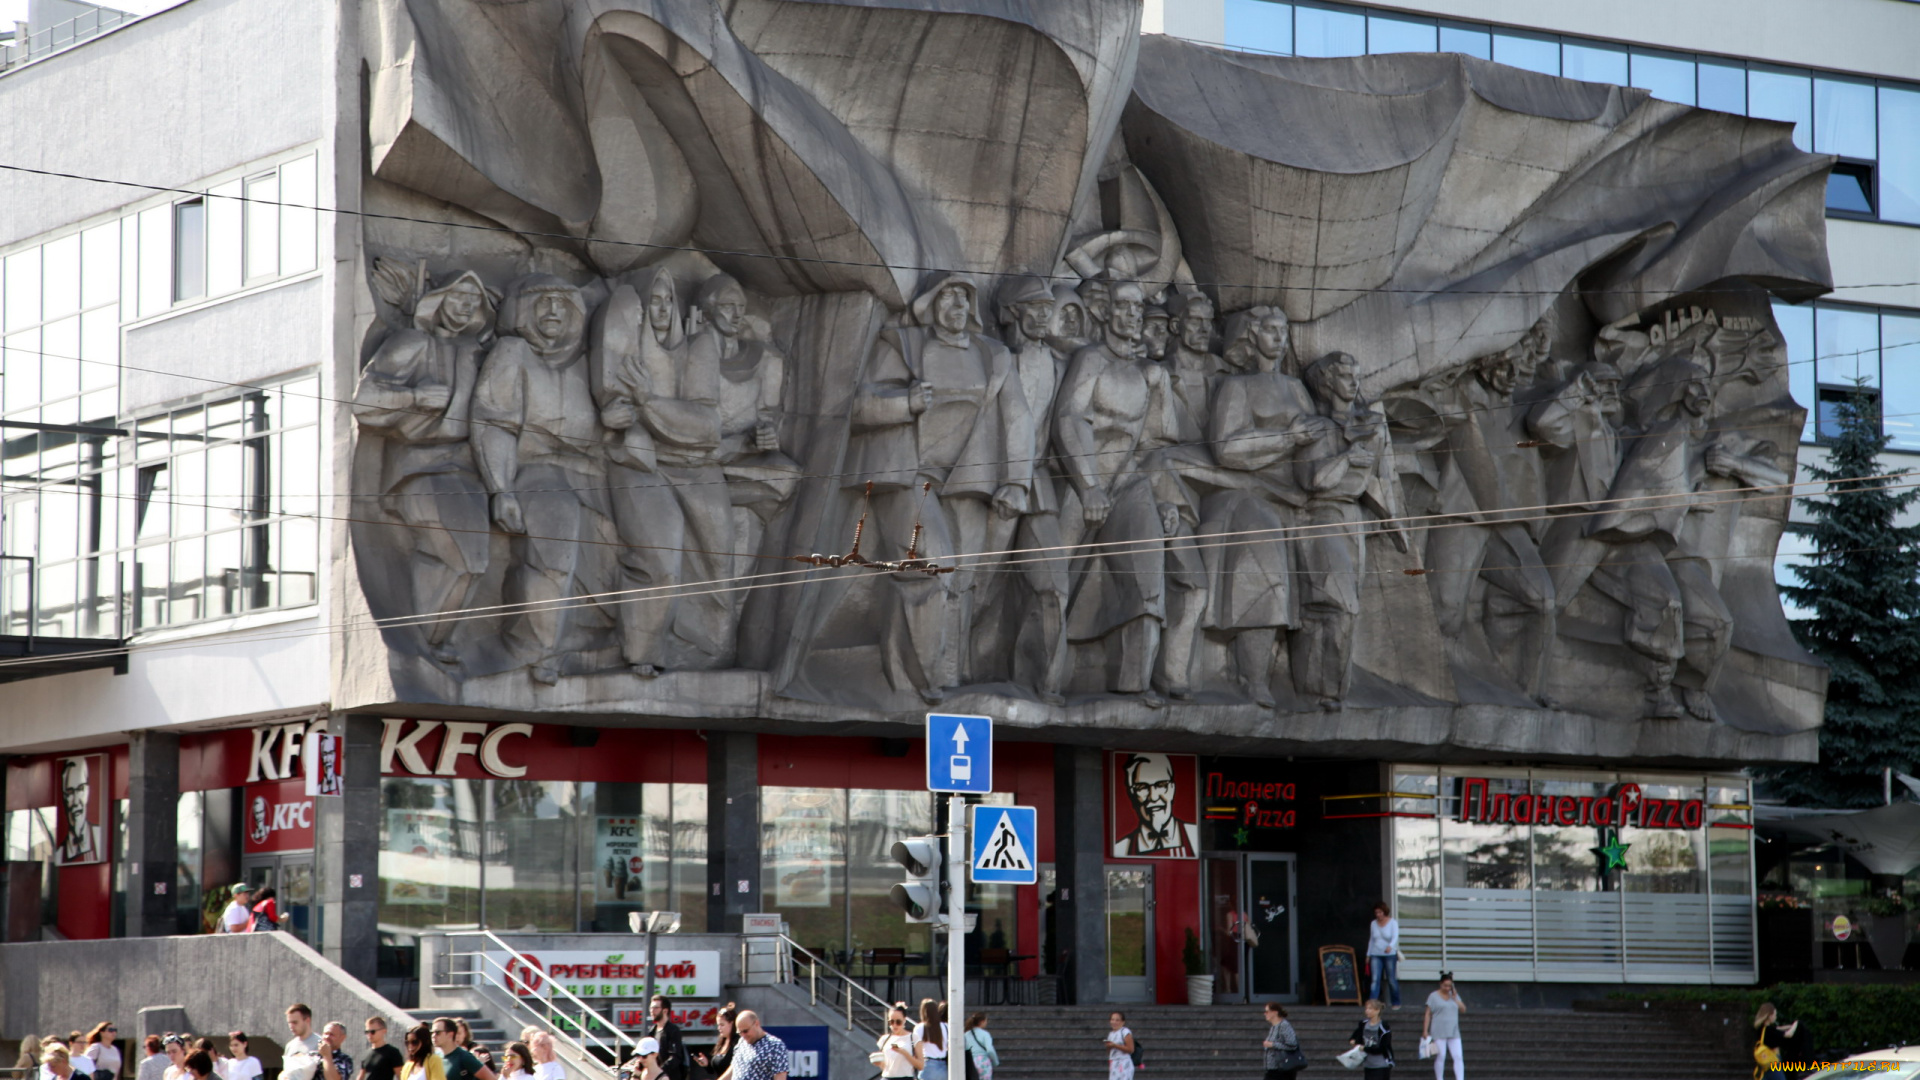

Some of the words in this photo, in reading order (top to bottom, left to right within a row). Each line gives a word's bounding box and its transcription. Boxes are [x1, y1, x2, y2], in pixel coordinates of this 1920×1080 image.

[380, 718, 534, 778] KFC
[1206, 771, 1296, 800] Планета
[271, 801, 312, 831] KFC
[1244, 800, 1296, 828] Pizza
[1460, 778, 1613, 826] Планета
[1617, 783, 1703, 828] Pizza
[610, 826, 634, 836] KFC
